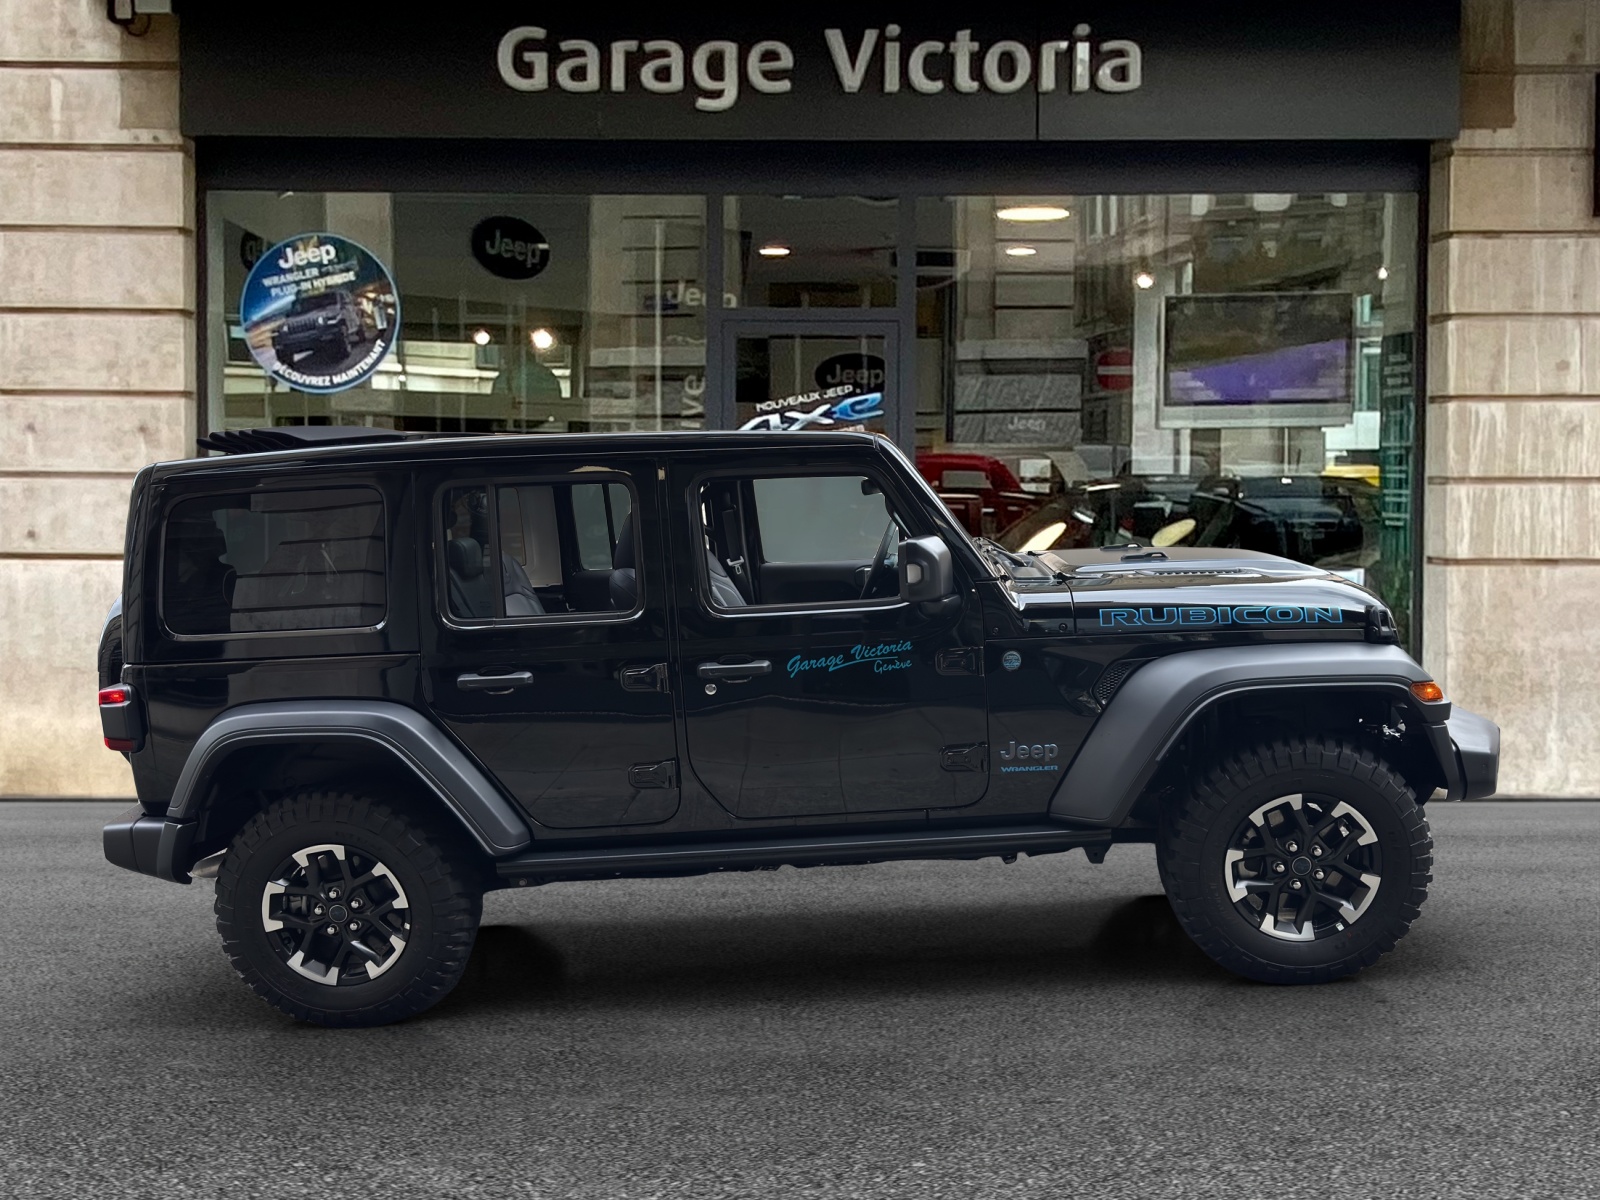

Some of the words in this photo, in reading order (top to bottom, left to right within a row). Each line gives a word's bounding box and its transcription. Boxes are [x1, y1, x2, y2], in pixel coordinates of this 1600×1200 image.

[497, 25, 794, 112] Garage
[824, 23, 1142, 93] Victoria
[278, 244, 336, 269] Jeep
[485, 229, 541, 268] Jeep
[262, 267, 320, 288] WRANGLER
[273, 361, 331, 386] DÉCOUVREZ
[332, 339, 386, 384] MAINTENANT
[826, 363, 884, 388] Jeep
[755, 391, 821, 412] NOUVEAUX
[823, 384, 854, 399] JEEP
[1099, 605, 1343, 627] RUBICON
[786, 654, 844, 678] Garage
[850, 640, 913, 660] Victoria
[873, 660, 912, 674] Genève
[1000, 741, 1059, 762] Jeep
[1000, 764, 1059, 773] WRANGLER
